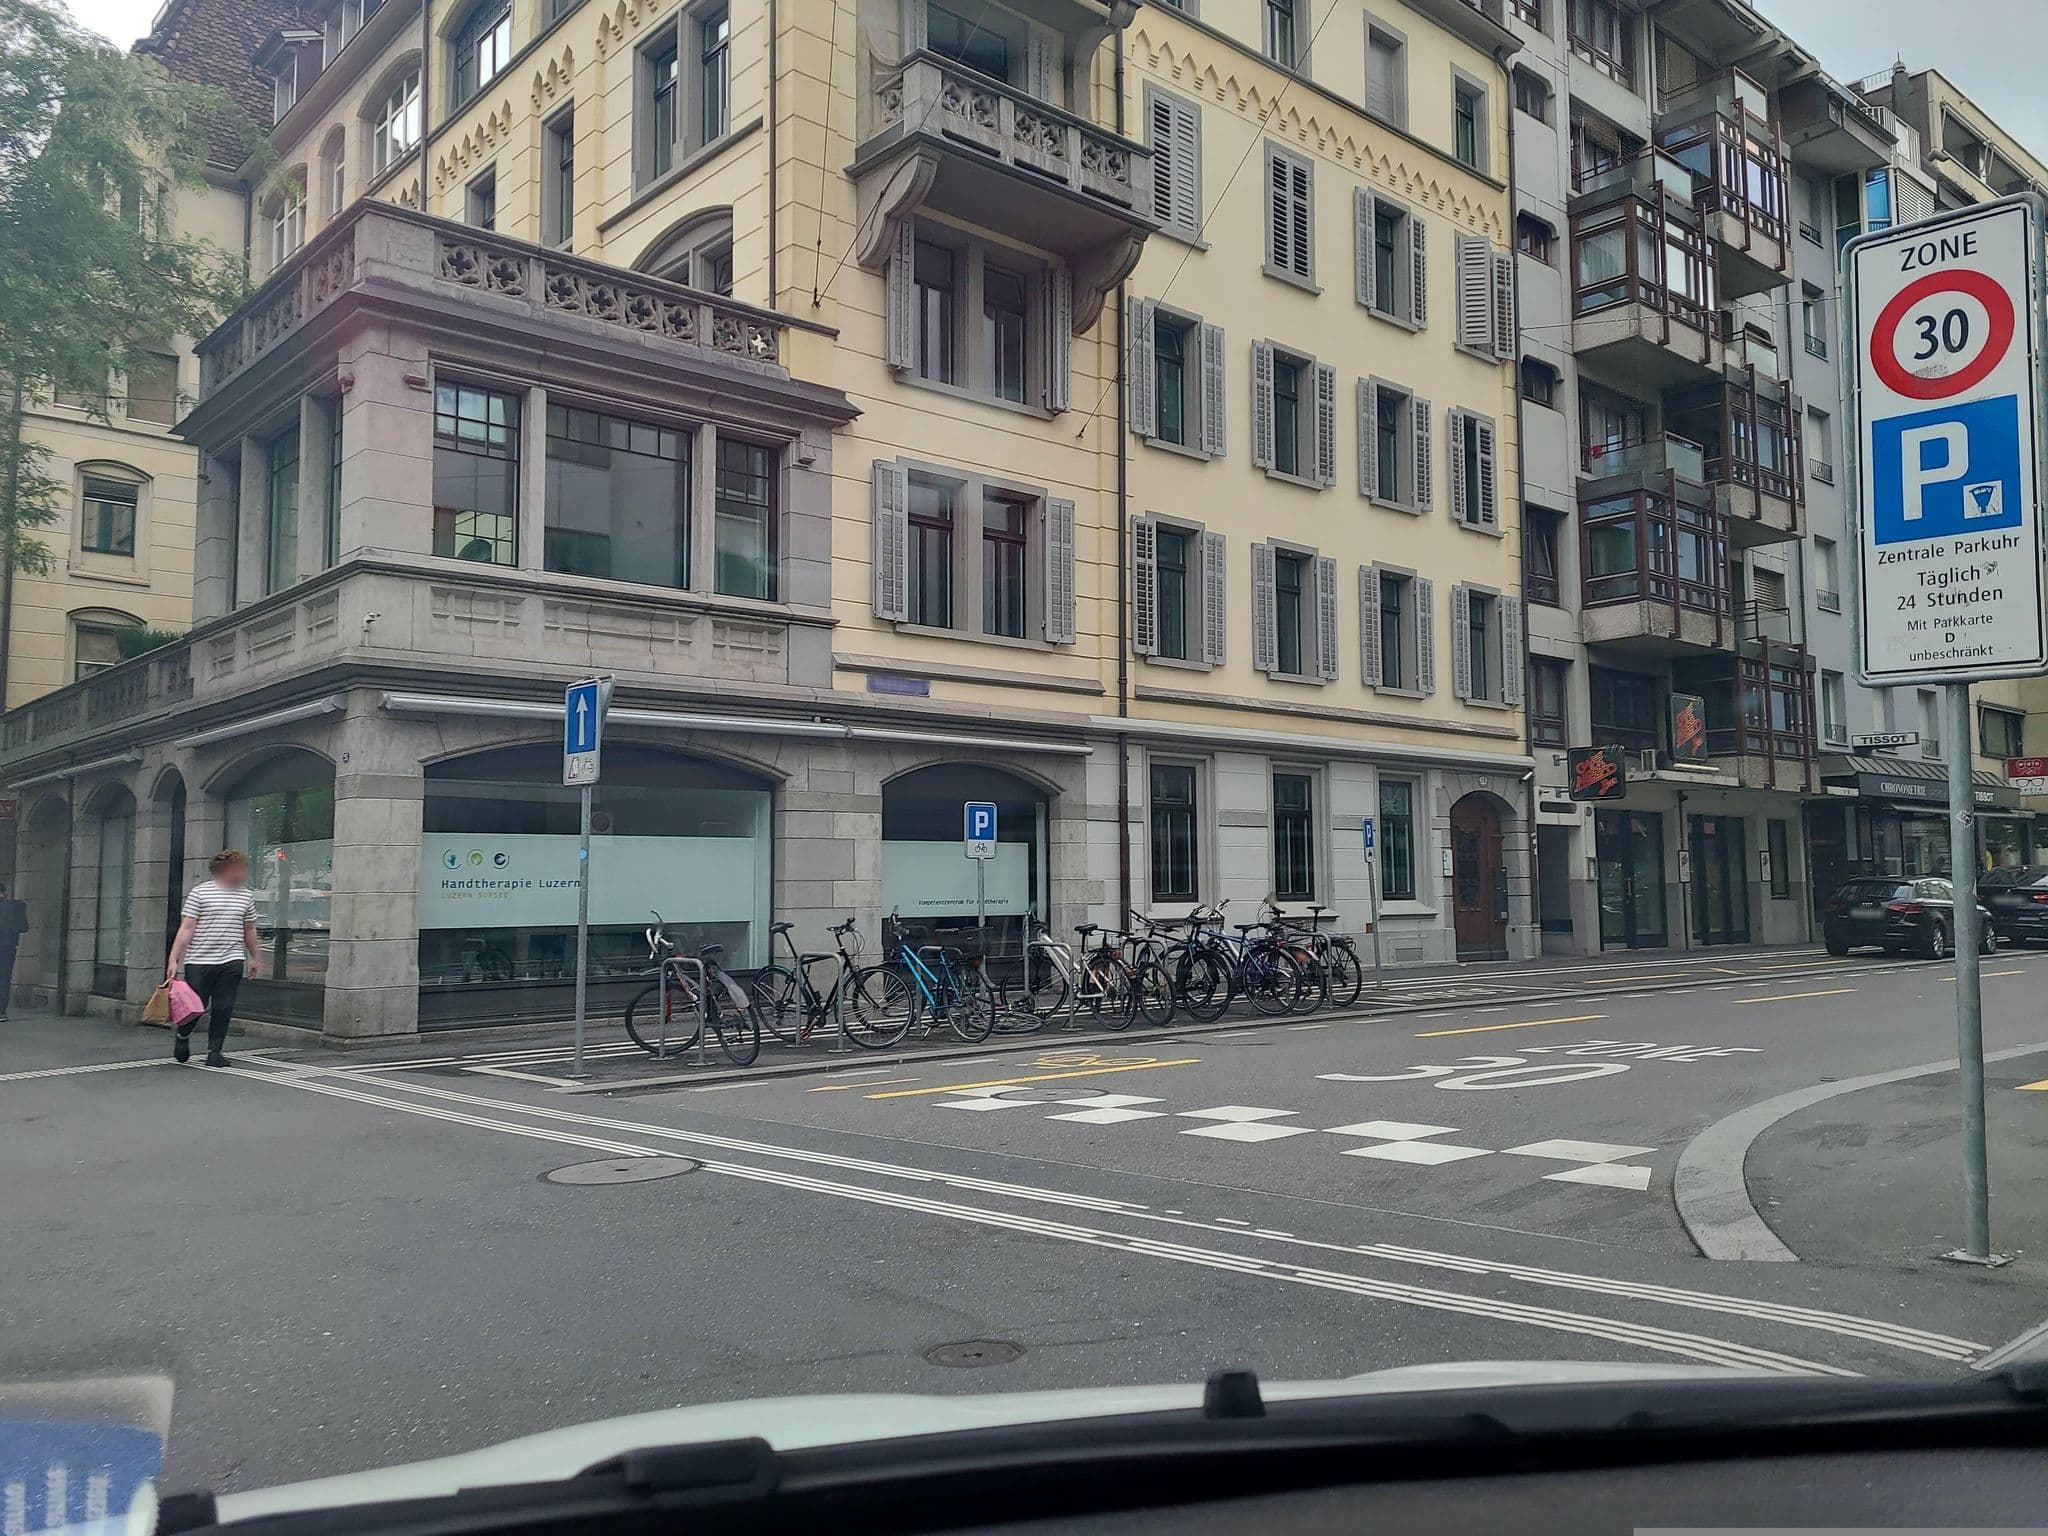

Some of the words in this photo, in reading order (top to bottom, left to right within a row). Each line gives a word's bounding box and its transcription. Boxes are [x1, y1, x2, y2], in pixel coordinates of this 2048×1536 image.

[1900, 231, 1977, 272] ZONE
[1914, 308, 1969, 360] 30
[1901, 421, 1969, 521] P
[1878, 544, 1945, 565] Zentrale
[1954, 534, 2020, 554] Parkuhr
[1917, 565, 1981, 588] Täglich
[1897, 595, 1916, 610] 24
[1927, 587, 2003, 608] Stunden
[1907, 619, 1927, 631] Mit
[1933, 614, 1993, 629] Parkkarte
[1945, 632, 1955, 643] D
[1909, 644, 1994, 662] unbeschränkt
[1860, 735, 1905, 745] TISSOT
[975, 811, 989, 837] P
[441, 878, 532, 890] Handtherapie
[539, 879, 581, 888] Luzern
[1515, 1040, 1764, 1062] ZONE
[1314, 1055, 1632, 1090] 30
